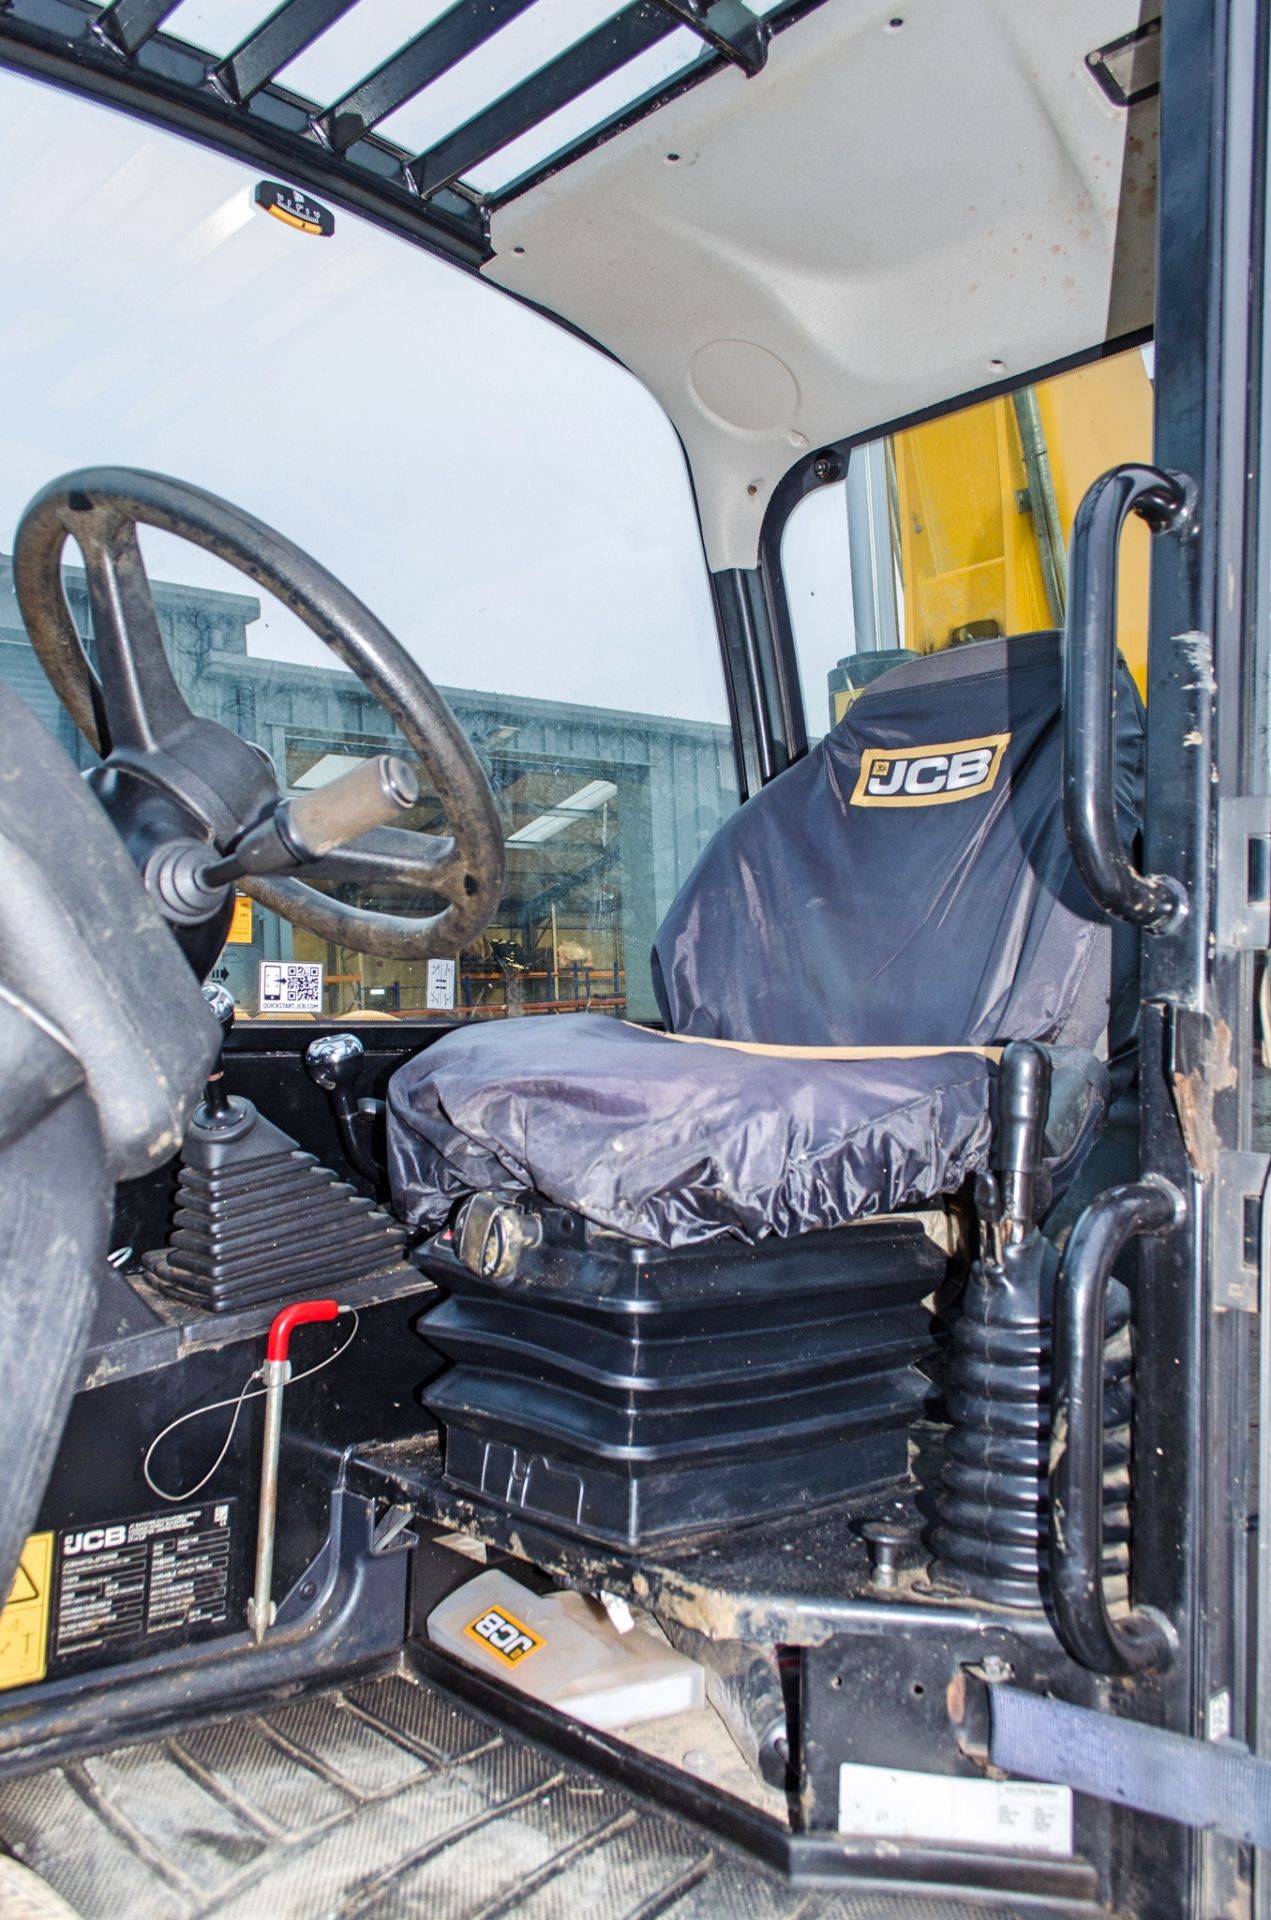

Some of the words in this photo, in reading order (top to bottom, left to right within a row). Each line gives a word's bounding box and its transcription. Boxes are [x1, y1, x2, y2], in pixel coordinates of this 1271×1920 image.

[277, 193, 284, 201] 10
[313, 210, 321, 219] 10
[868, 749, 992, 795] JCB
[262, 1002, 319, 1010] QUICKSTART.JCB.COM
[64, 1525, 127, 1555] JCB
[475, 1612, 533, 1655] JCB
